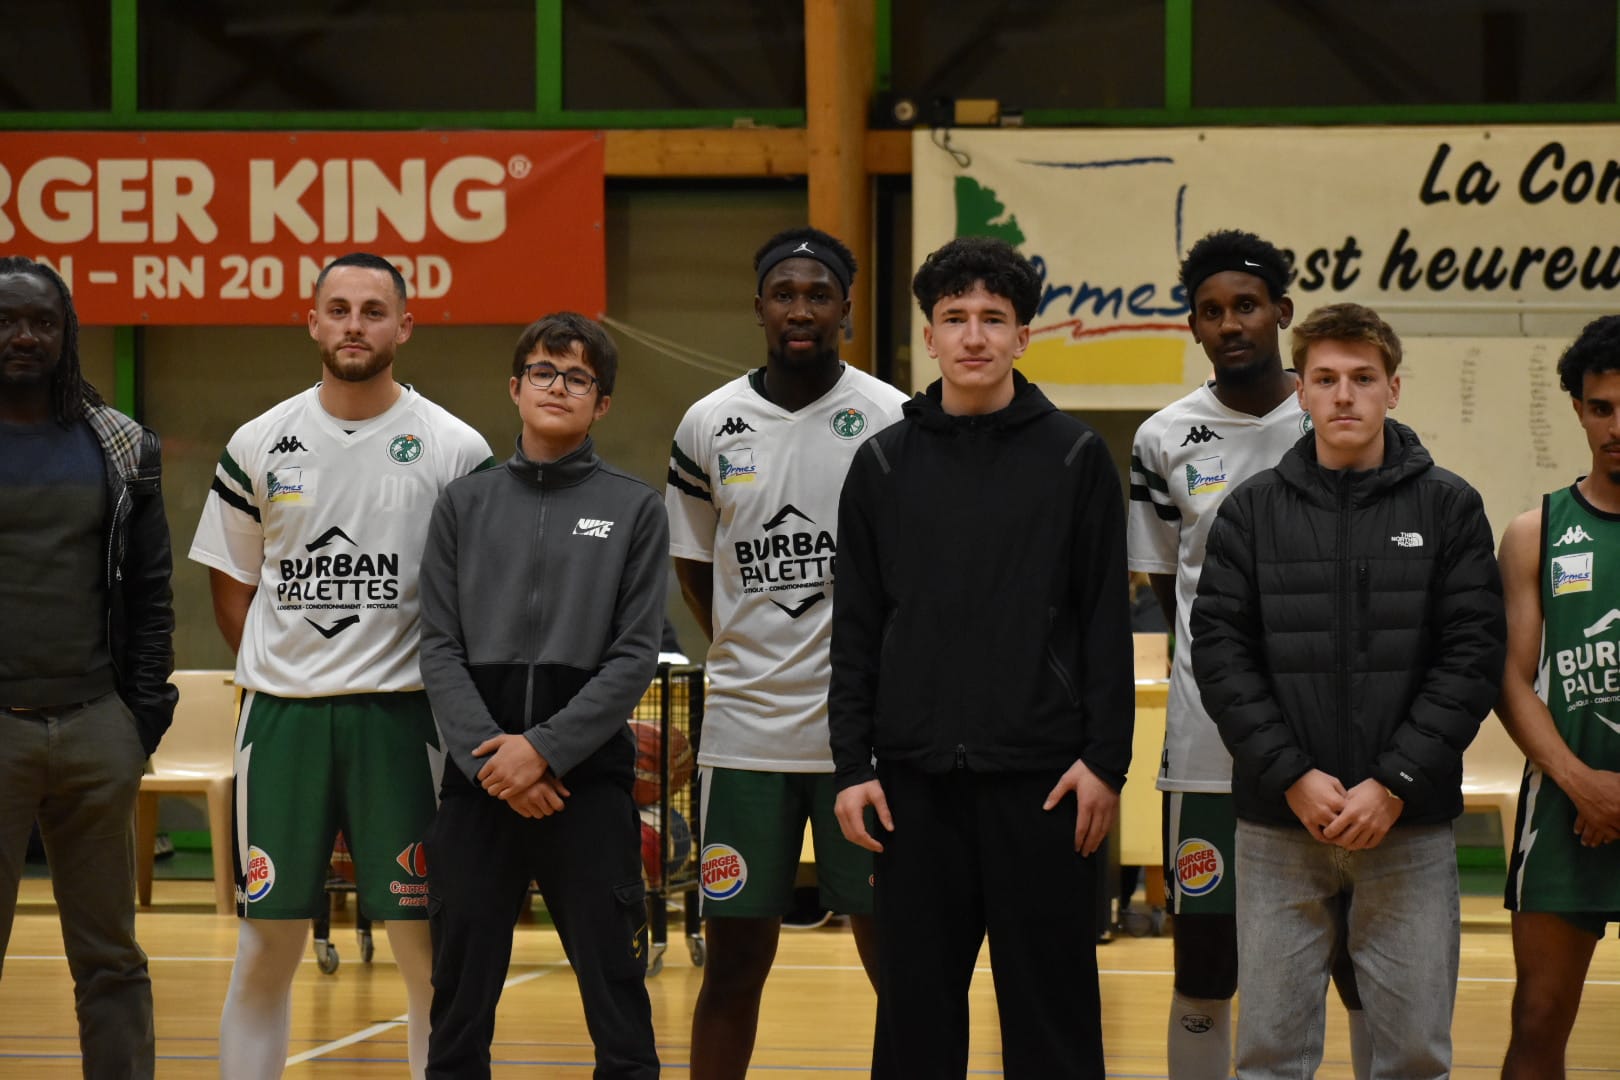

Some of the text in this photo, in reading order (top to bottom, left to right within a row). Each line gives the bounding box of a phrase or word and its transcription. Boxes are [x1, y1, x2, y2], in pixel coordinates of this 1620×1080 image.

[1419, 143, 1500, 205] La
[1379, 228, 1620, 291] heureu
[133, 255, 204, 299] RN
[220, 254, 284, 300] 20
[299, 255, 453, 300] NRD
[735, 530, 838, 565] BURBA
[280, 553, 399, 582] BURBAN
[276, 579, 399, 602] PALETTES
[1556, 641, 1620, 677] BUR
[701, 855, 738, 873] BURGER
[1177, 848, 1215, 870] BURGER
[1179, 858, 1217, 883] KING
[703, 864, 740, 887] KING
